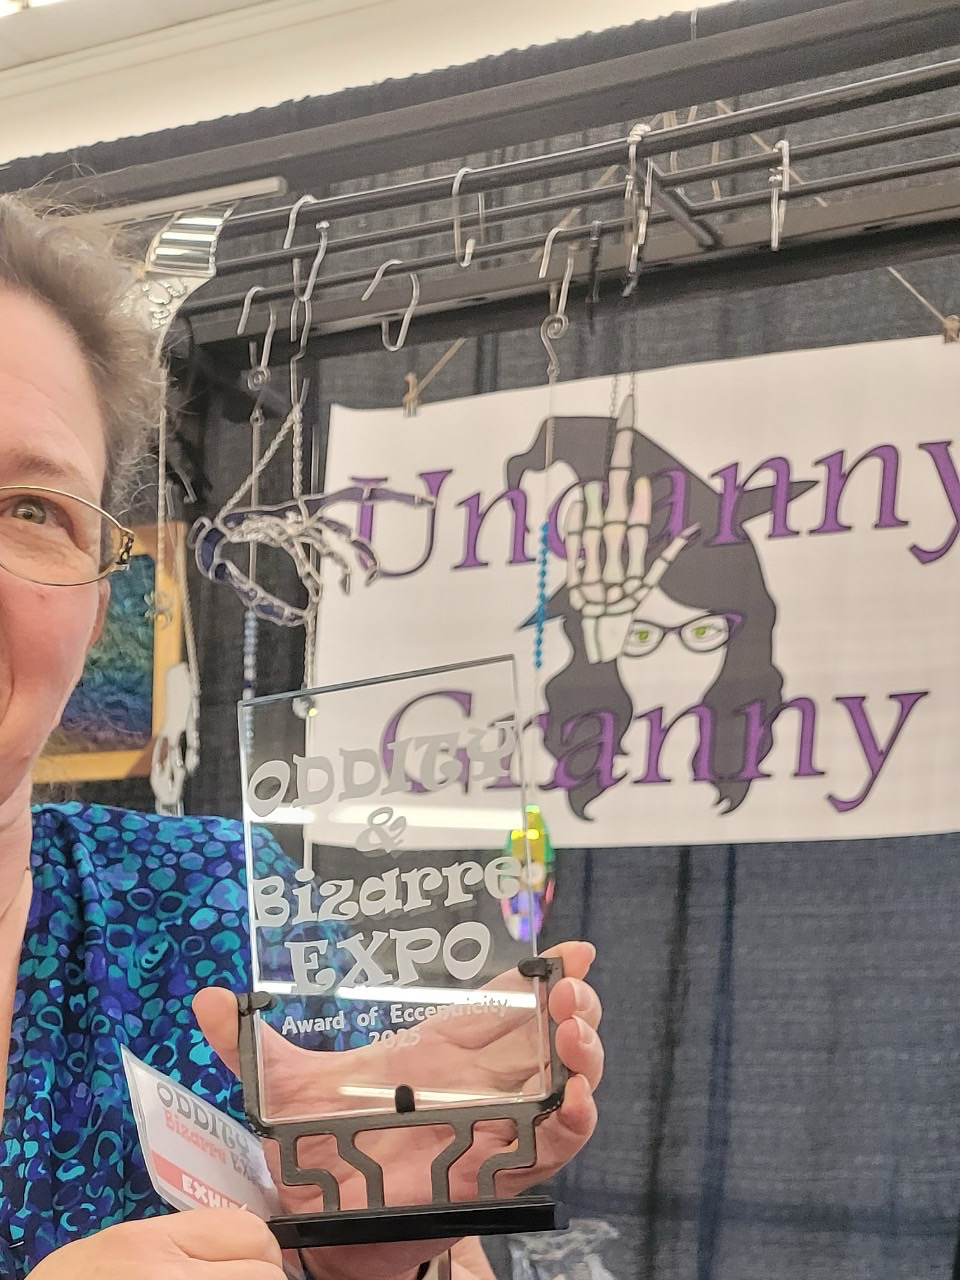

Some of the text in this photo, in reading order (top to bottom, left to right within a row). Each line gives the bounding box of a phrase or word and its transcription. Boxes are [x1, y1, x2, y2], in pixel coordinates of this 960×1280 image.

[251, 856, 522, 928] Bizarre
[284, 921, 491, 994] EXPO
[282, 1011, 345, 1036] Award
[356, 1006, 379, 1027] of
